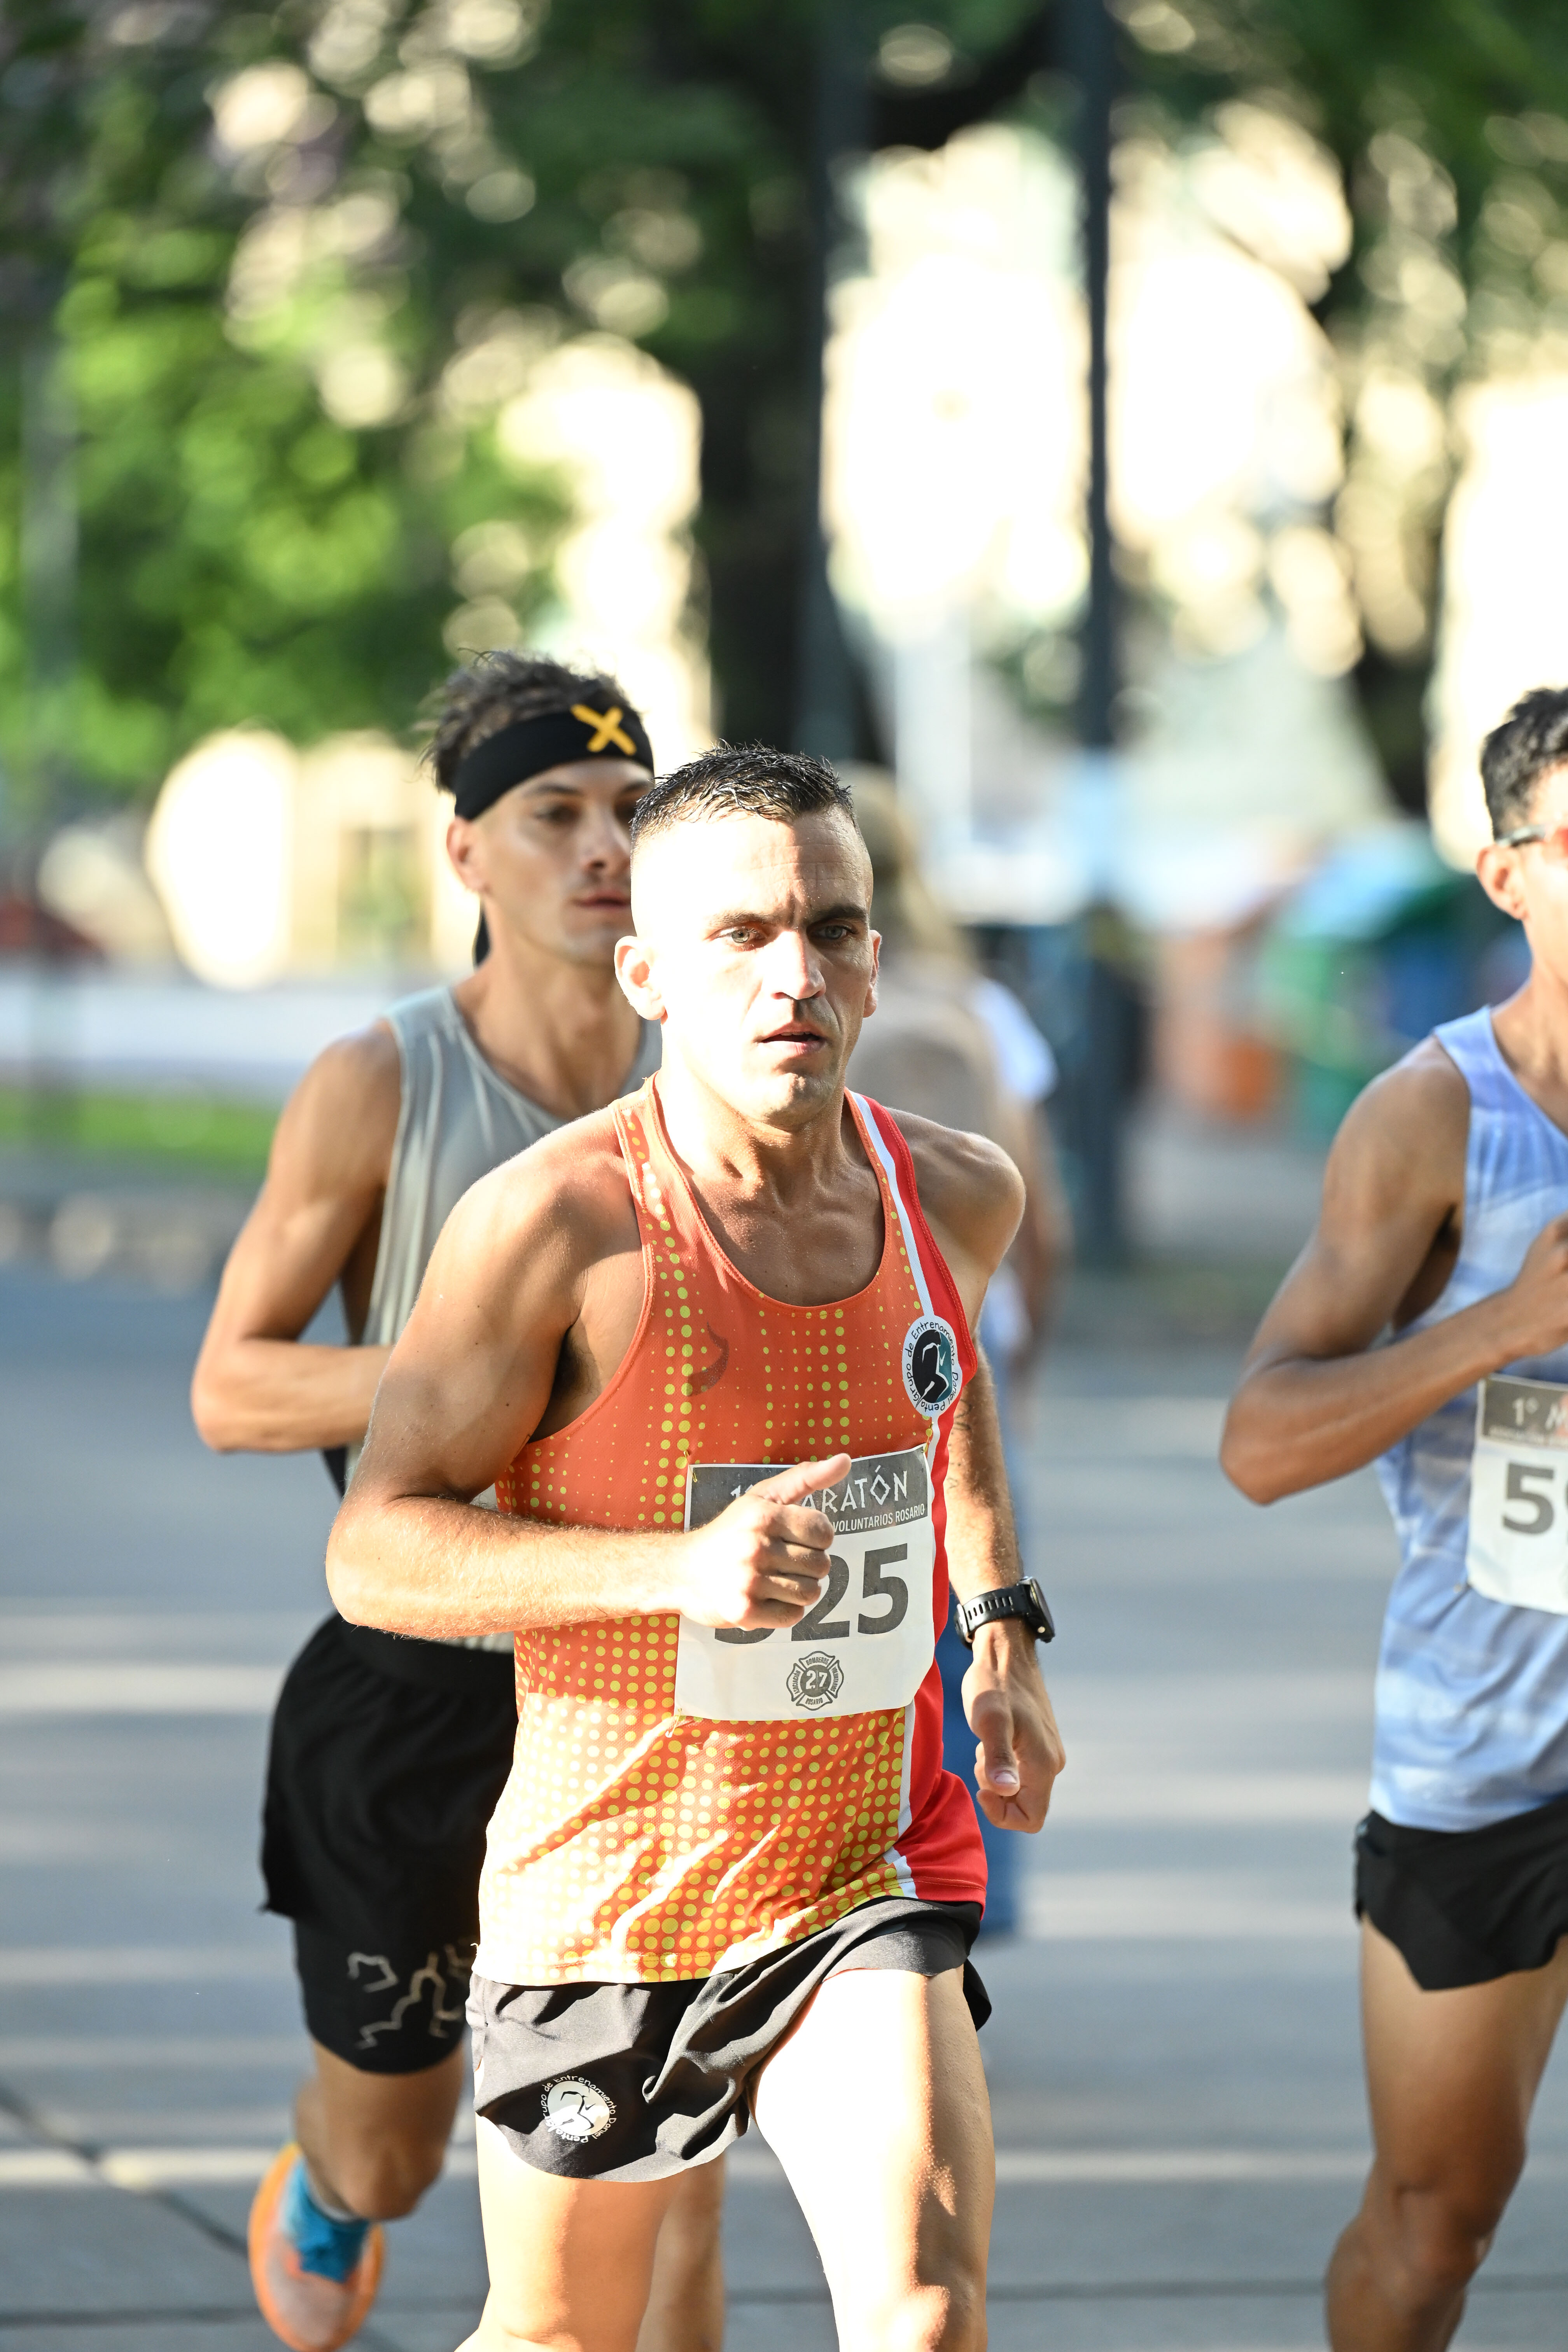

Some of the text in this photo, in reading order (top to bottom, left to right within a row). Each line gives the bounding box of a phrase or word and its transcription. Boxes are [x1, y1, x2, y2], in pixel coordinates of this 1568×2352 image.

[905, 1322, 959, 1412] Grupo de Entrenamiento Daniel Penta
[802, 1465, 908, 1513] ARATÓN
[833, 1503, 925, 1533] VOLUNTARIOS ROSARIO
[715, 1543, 909, 1644] 25
[805, 1670, 828, 1690] 27
[806, 1657, 829, 1666] BOMBEROS
[830, 1666, 839, 1692] VOLUNTARIOS
[541, 2075, 618, 2143] Grupo de Entrenamiento Daniel Penta
